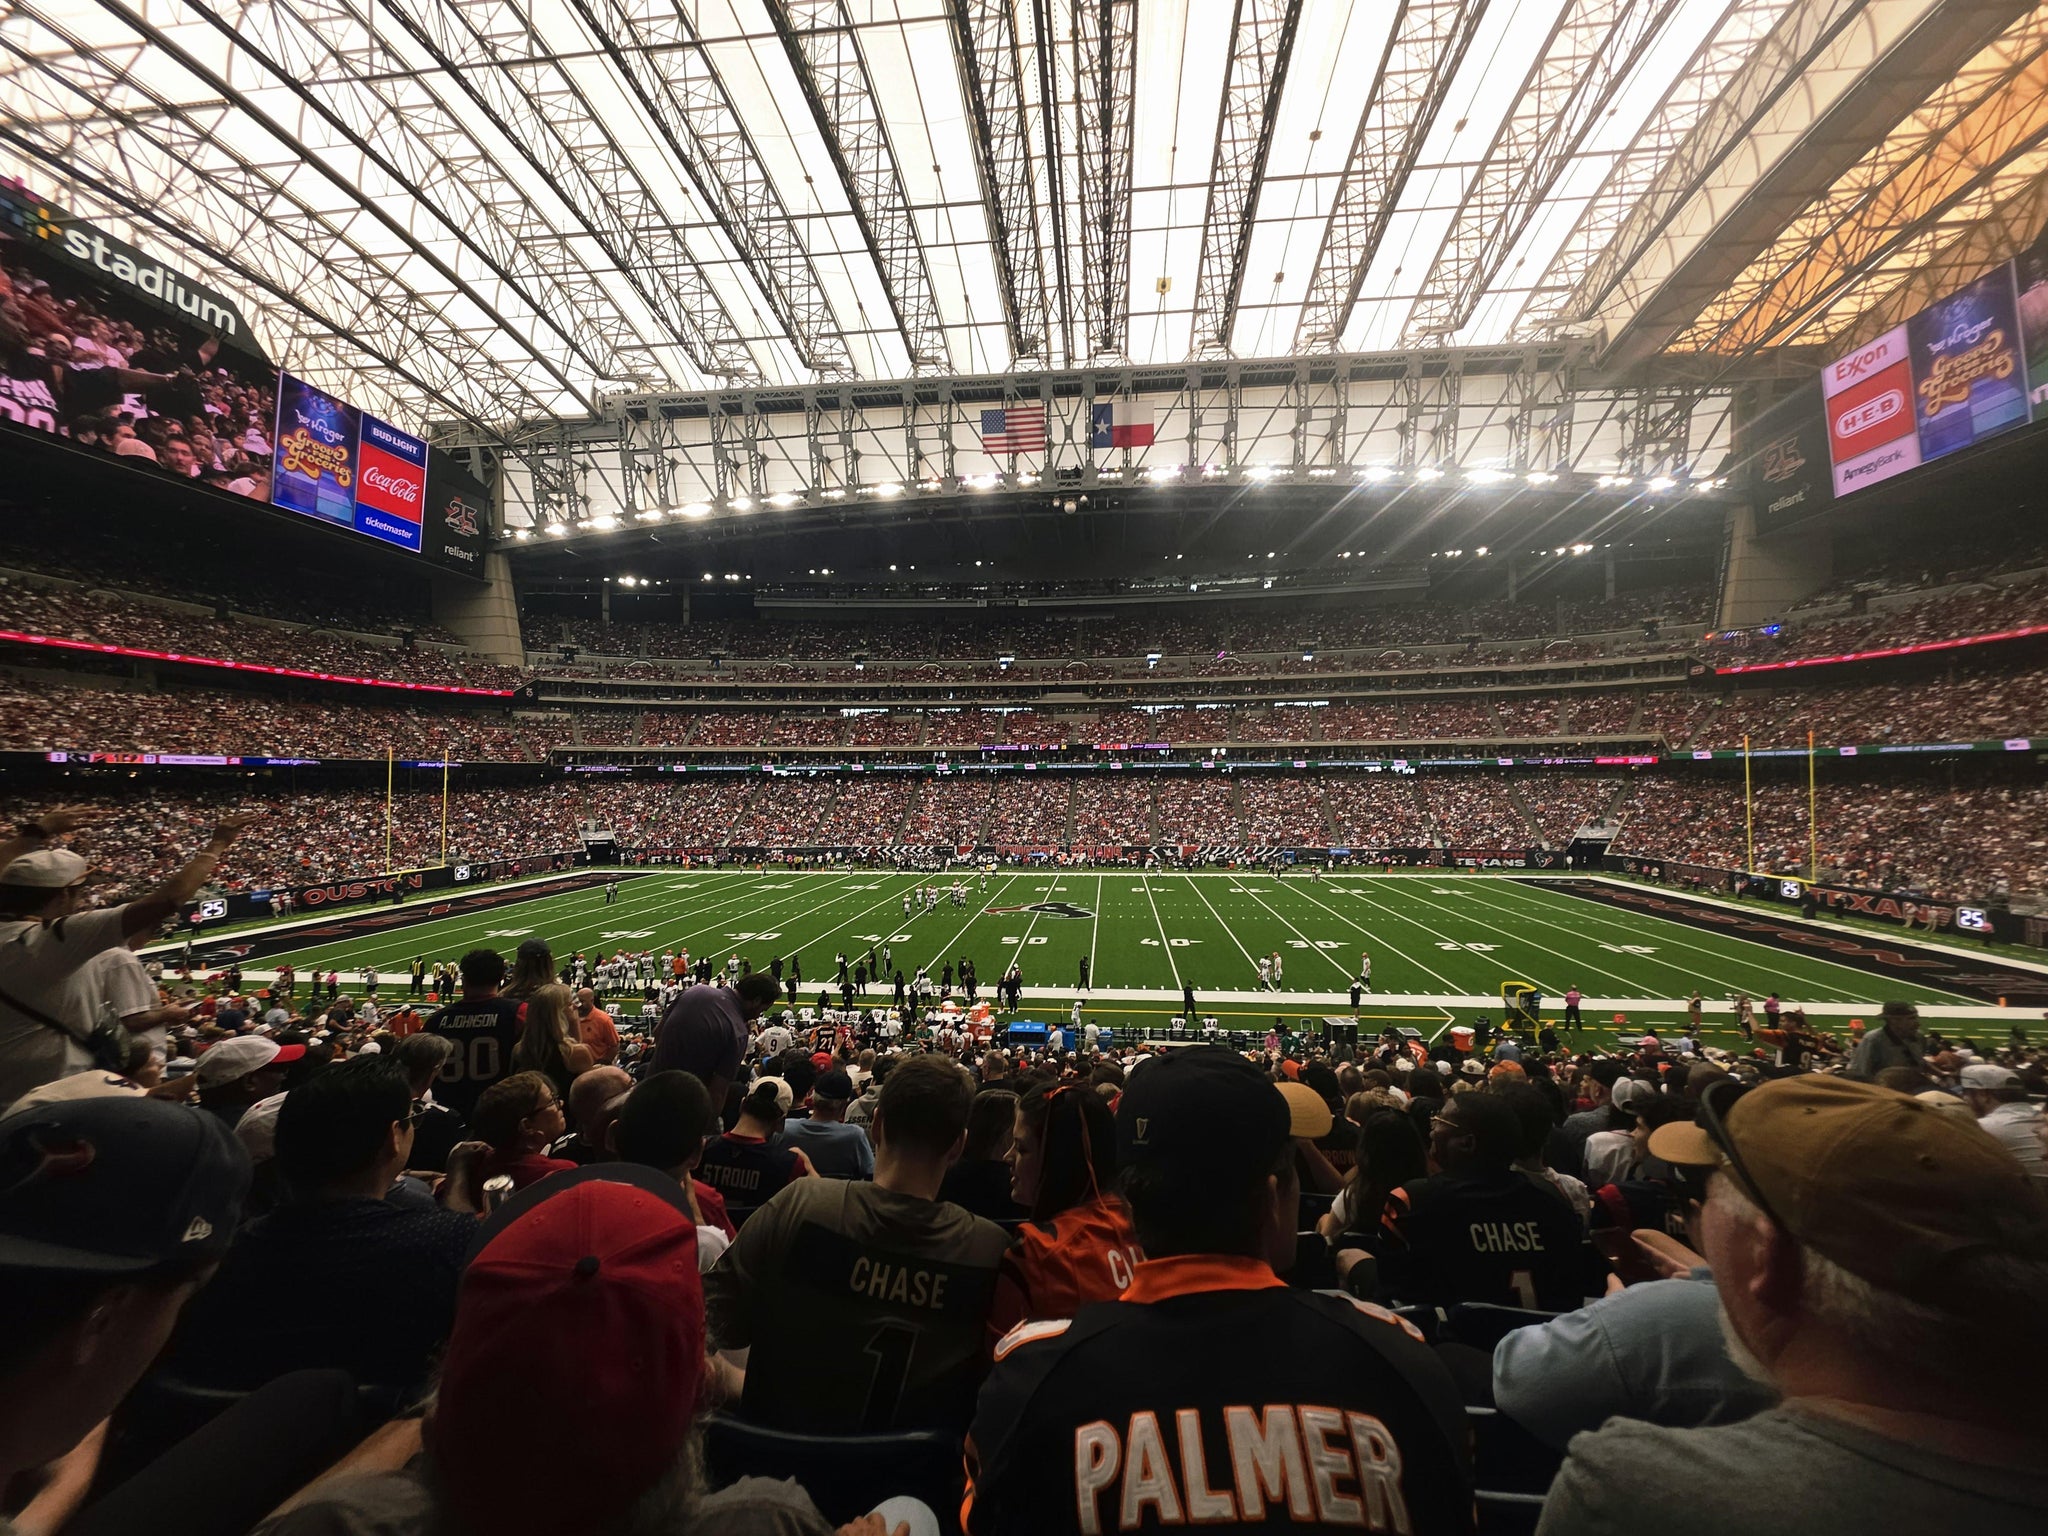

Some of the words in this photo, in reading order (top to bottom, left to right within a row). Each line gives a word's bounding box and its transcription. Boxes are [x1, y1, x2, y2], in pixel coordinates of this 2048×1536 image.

[64, 229, 236, 335] stadium
[1836, 343, 1888, 382] Exxon
[311, 418, 345, 443] Kroger
[296, 429, 348, 461] Groove
[373, 427, 392, 443] BUD
[392, 436, 418, 455] LIGHT
[1768, 490, 1805, 513] reliant
[365, 517, 413, 539] ticketmaster
[444, 545, 474, 562] reliant
[1452, 851, 1526, 859] HOUSTON
[456, 867, 468, 879] 25
[1782, 882, 1798, 896] 25
[202, 901, 224, 917] 25
[1960, 910, 1984, 928] 25
[863, 934, 912, 942] 40
[1000, 936, 1048, 945] 50
[1140, 937, 1190, 947] 40
[1285, 940, 1339, 949] 30
[439, 1013, 499, 1029] A.JOHNSON
[770, 1039, 777, 1052] 9
[819, 1037, 833, 1050] 21
[702, 1163, 761, 1190] STROUD
[1469, 1222, 1545, 1252] CHASE
[849, 1256, 948, 1310] CHASE
[1510, 1270, 1538, 1309] 1
[856, 1322, 921, 1431] 1
[1075, 1404, 1413, 1536] PALMER
